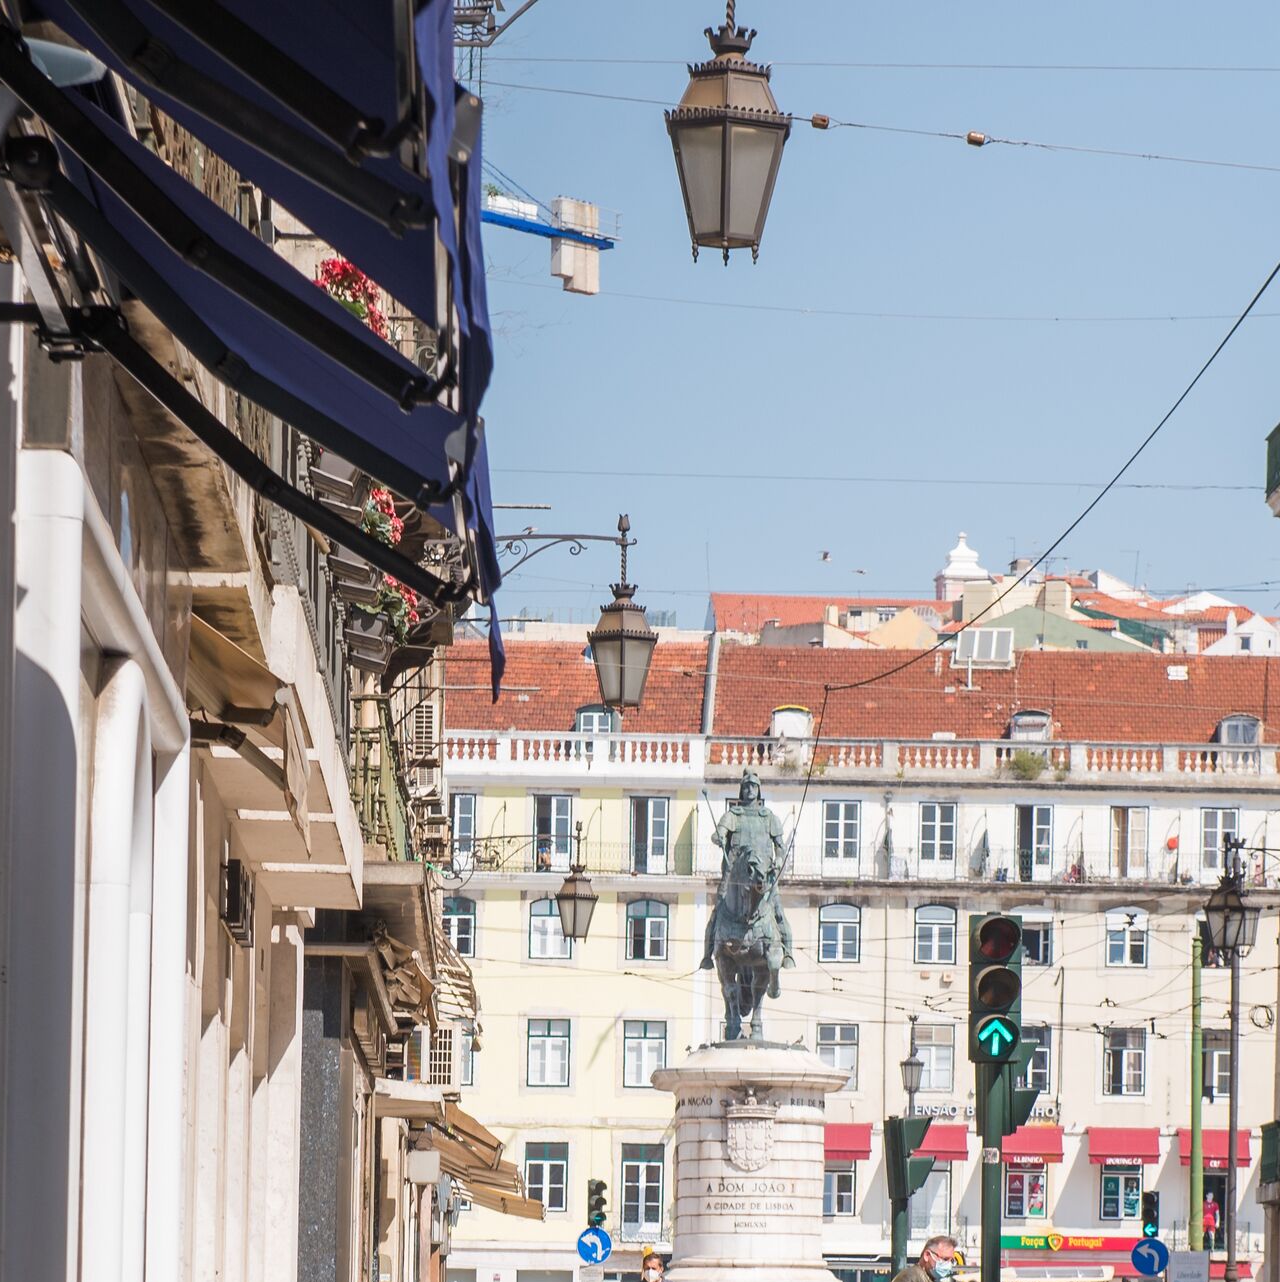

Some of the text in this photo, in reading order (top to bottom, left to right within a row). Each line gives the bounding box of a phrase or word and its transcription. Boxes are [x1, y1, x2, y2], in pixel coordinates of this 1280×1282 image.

[718, 1182, 744, 1193] DOM
[714, 1202, 745, 1210] CIDADE
[750, 1202, 761, 1210] DE
[765, 1202, 794, 1210] LISBOA
[1021, 1236, 1045, 1249] Força
